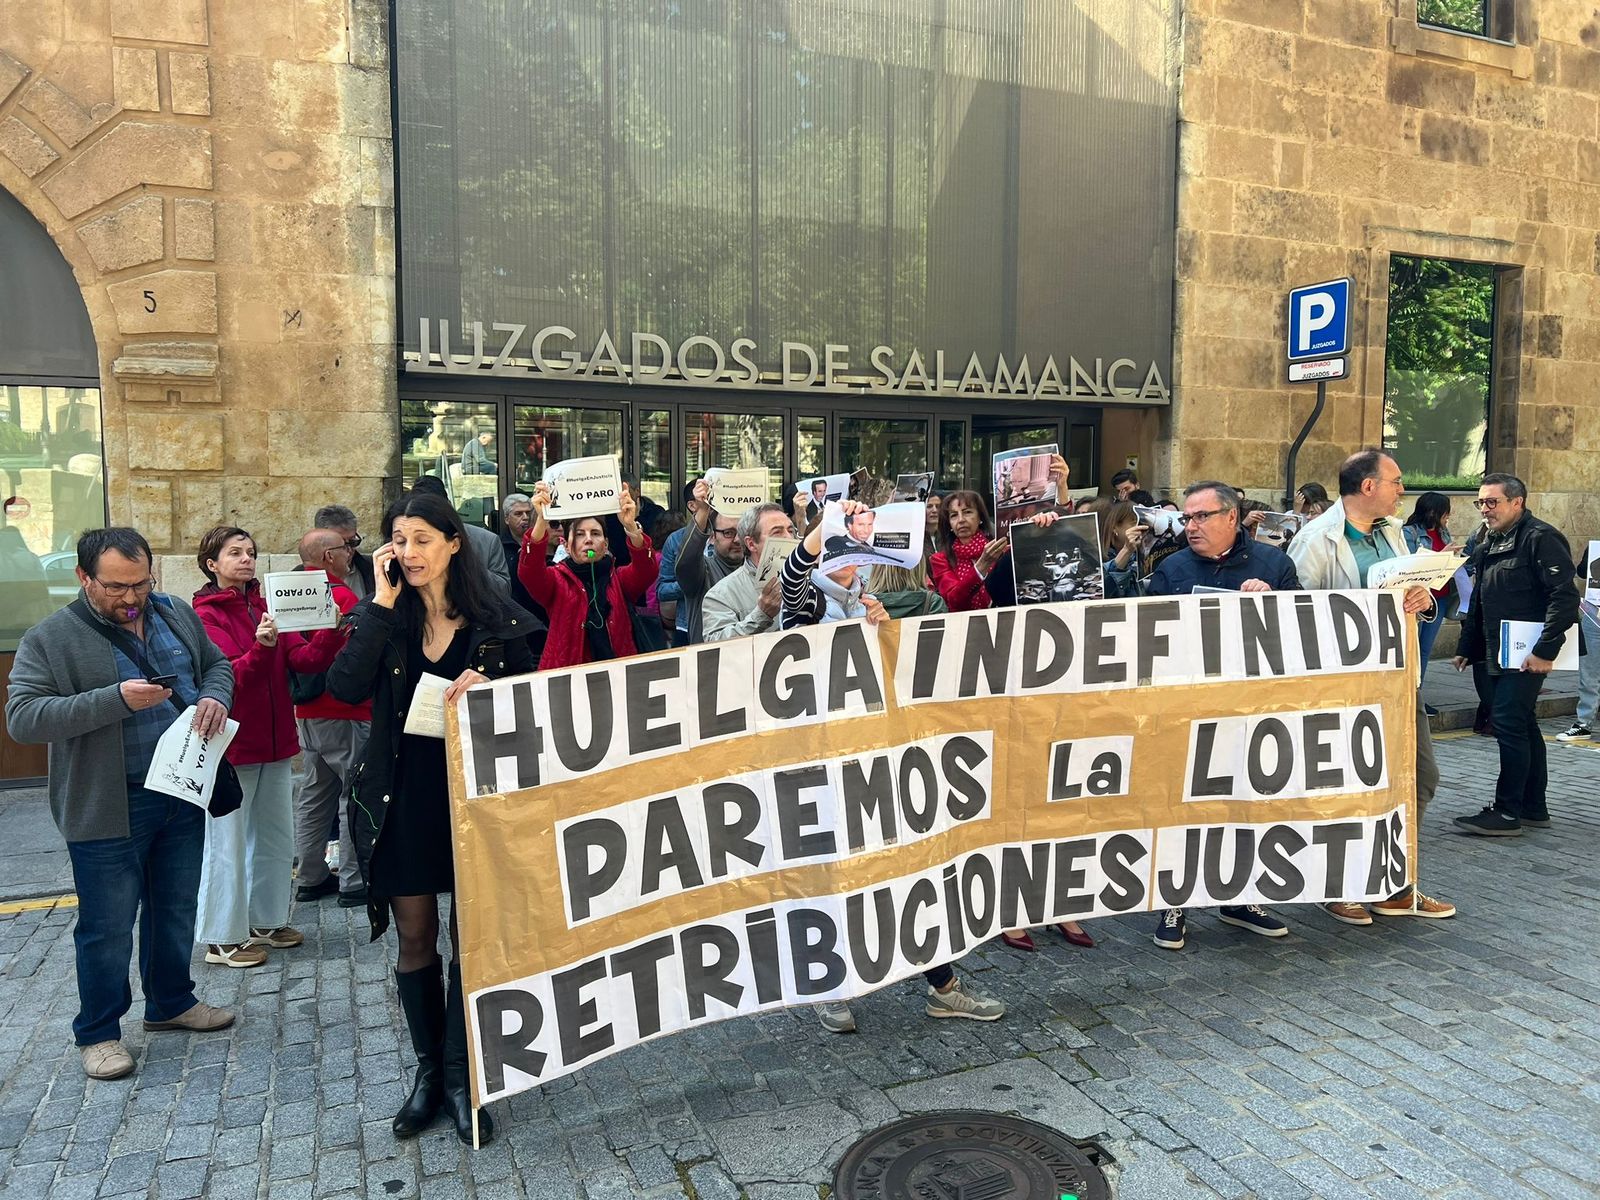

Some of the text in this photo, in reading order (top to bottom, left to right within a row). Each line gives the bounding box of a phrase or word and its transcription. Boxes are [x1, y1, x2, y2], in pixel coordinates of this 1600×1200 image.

[143, 290, 157, 313] 5
[1299, 292, 1336, 351] P
[1311, 340, 1336, 350] JUZGADOS
[404, 317, 1170, 400] JUZGADOS DE SALAMANCA
[1300, 361, 1331, 369] RESERVADO
[1302, 371, 1330, 379] JUZGADOS
[566, 474, 613, 483] #HuelgaEnJusticia
[569, 489, 614, 501] YO PARO
[722, 496, 735, 504] YO
[275, 587, 317, 597] YO PARO
[467, 623, 886, 796] HUELGA
[196, 754, 205, 769] YO
[562, 709, 1383, 922] PAREMOS La LOEO
[1157, 810, 1407, 907] JUSTAS
